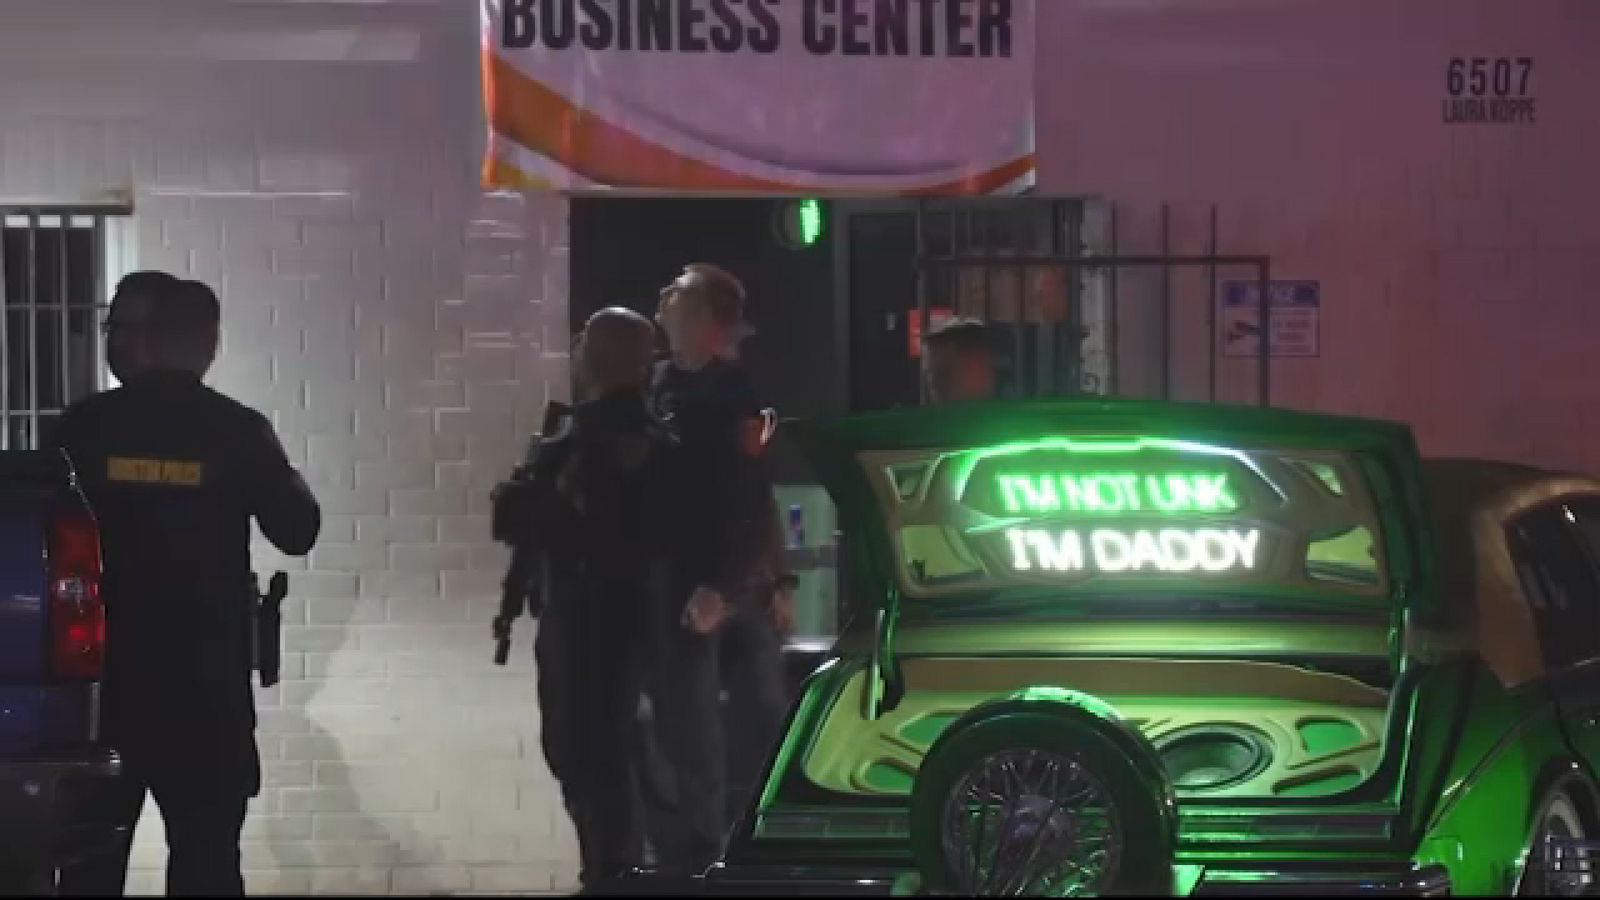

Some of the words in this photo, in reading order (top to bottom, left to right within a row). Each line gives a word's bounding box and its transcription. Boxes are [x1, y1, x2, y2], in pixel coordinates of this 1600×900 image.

[502, 0, 781, 54] BUSINESS
[803, 0, 1013, 58] CENTER
[1447, 57, 1534, 96] 6507
[996, 473, 1060, 512] I'M
[1061, 474, 1141, 511] NOT
[1145, 473, 1239, 510] UNK
[1006, 529, 1084, 570] I'M
[1091, 529, 1260, 570] DADDY
